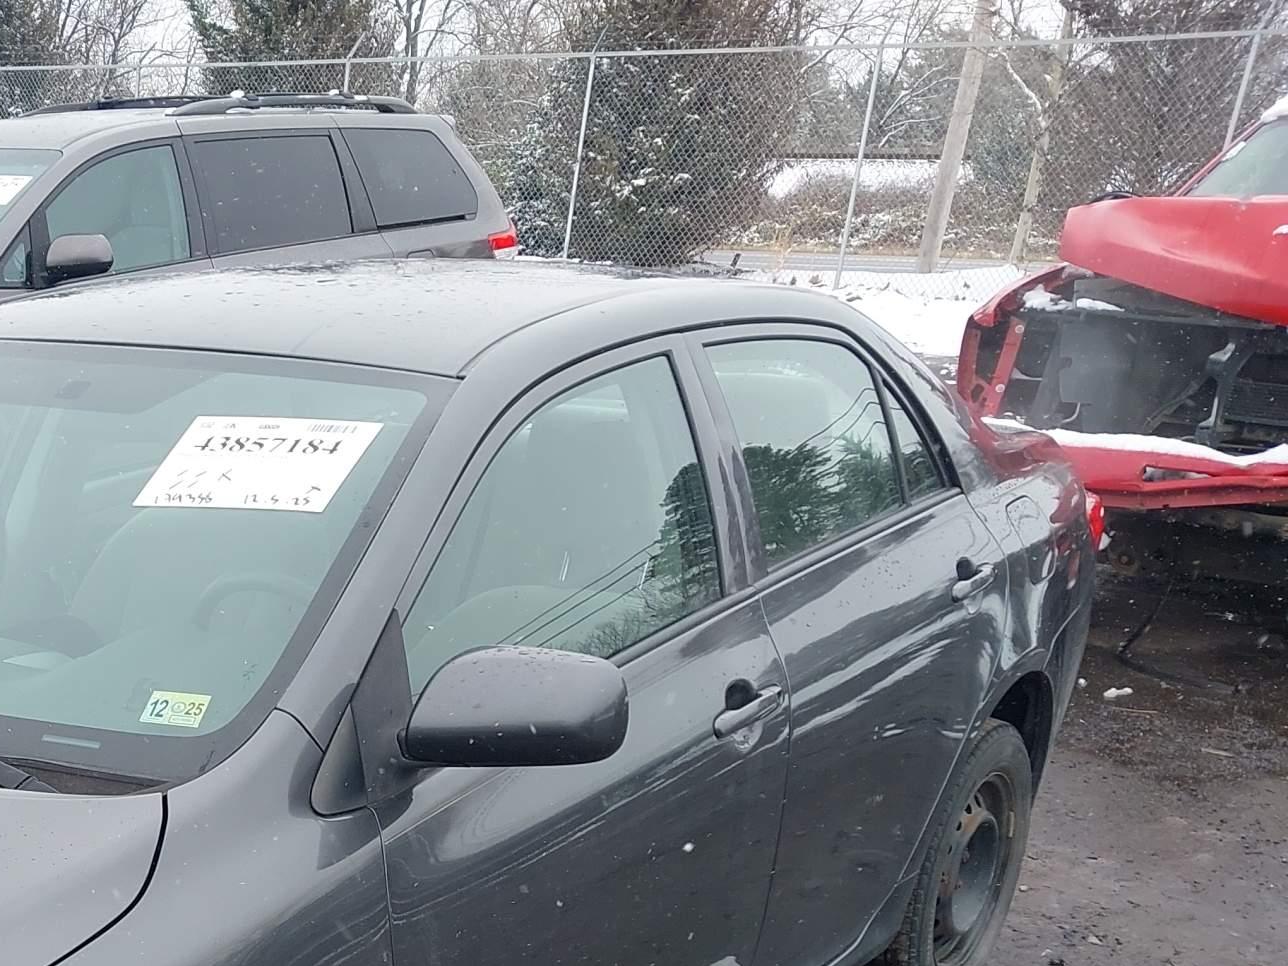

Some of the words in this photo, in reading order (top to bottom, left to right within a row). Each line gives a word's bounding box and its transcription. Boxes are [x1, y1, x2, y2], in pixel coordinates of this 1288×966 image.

[194, 435, 344, 455] 43857184
[150, 698, 169, 718] 12
[184, 702, 205, 717] 25
